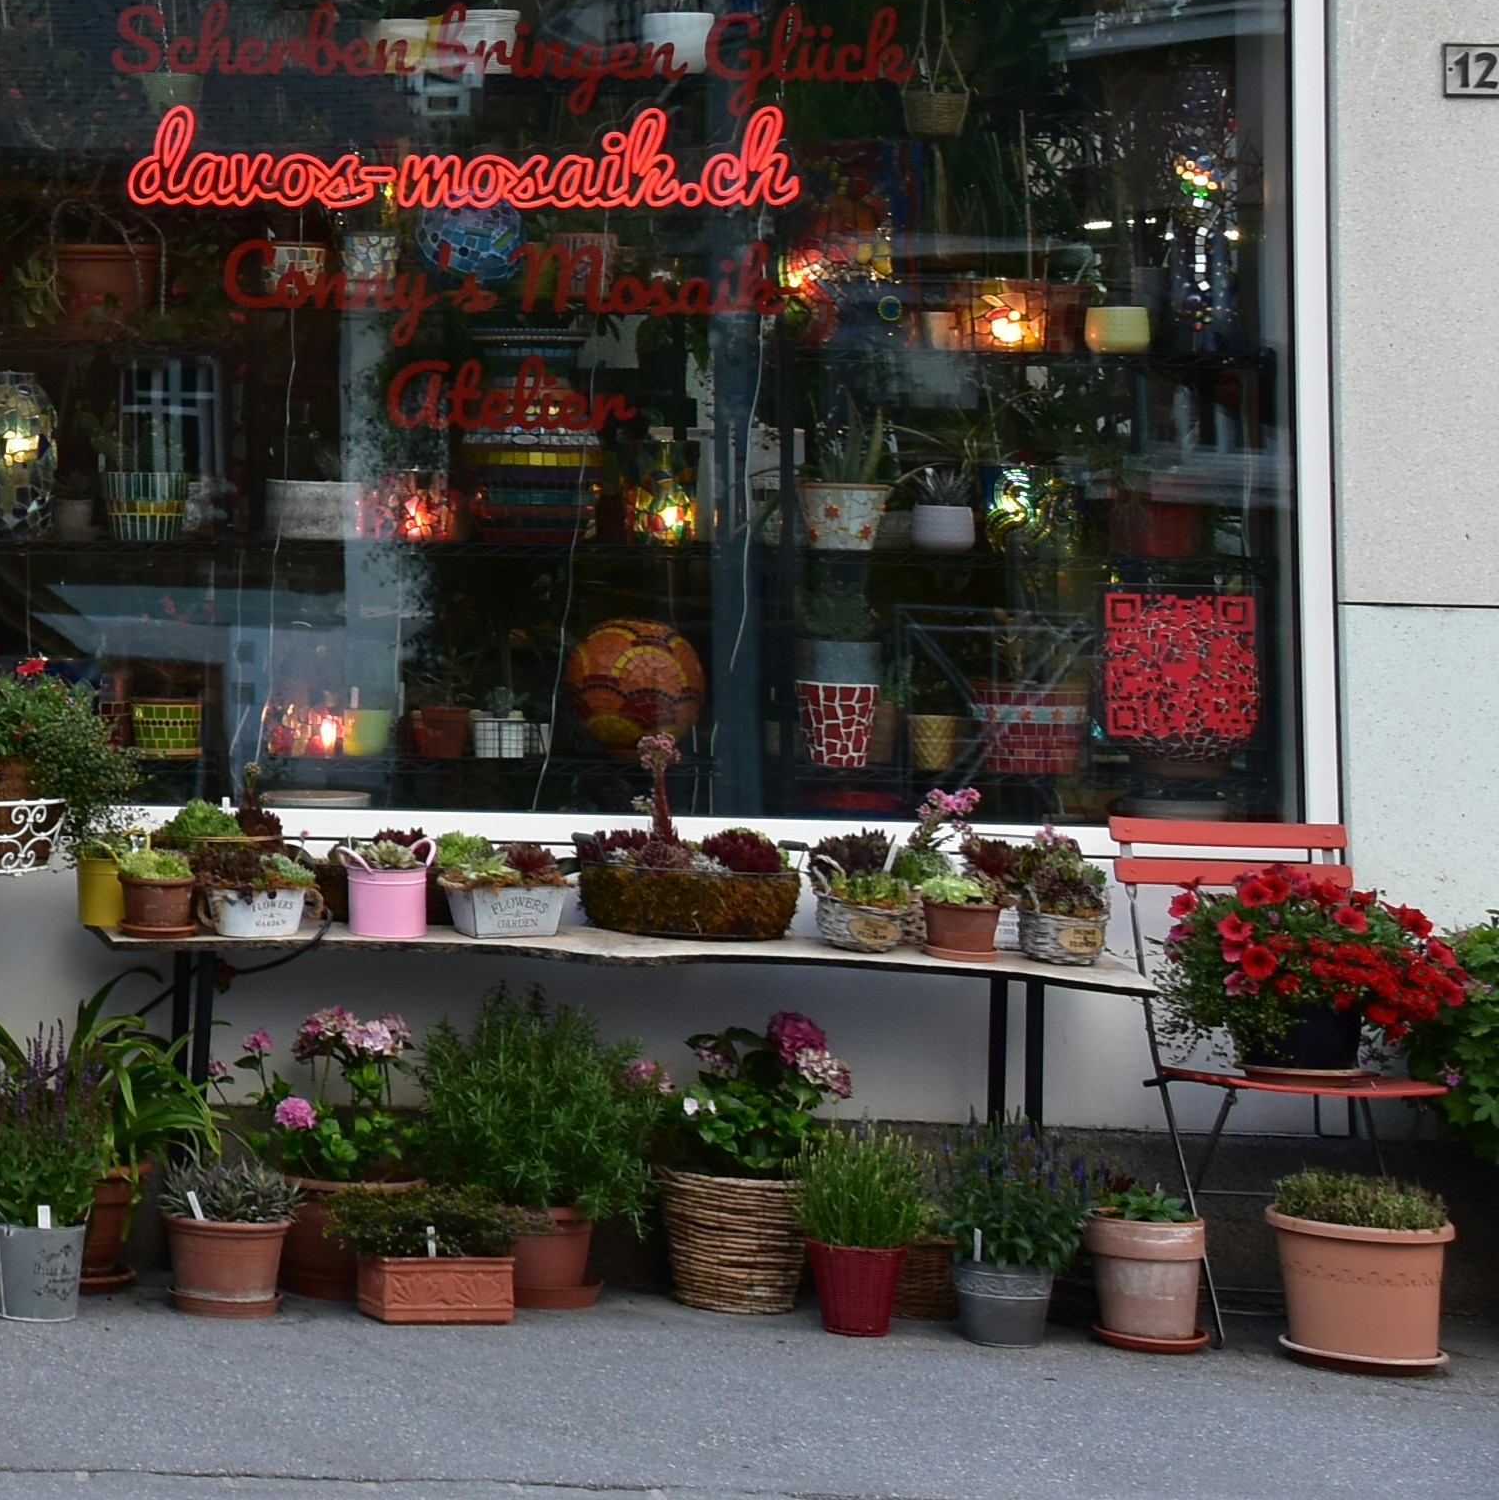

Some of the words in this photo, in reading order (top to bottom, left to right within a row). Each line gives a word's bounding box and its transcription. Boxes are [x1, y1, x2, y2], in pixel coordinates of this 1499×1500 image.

[111, 0, 414, 77] Scherben
[423, 2, 688, 114] bringen
[703, 6, 915, 115] Glück
[1453, 51, 1499, 90] 12
[127, 104, 801, 209] davos-mosaik.ch
[222, 238, 498, 347] Conny's
[512, 240, 793, 315] Mosaik
[387, 356, 636, 430] Atelier
[251, 899, 295, 913] FLOWERS
[491, 896, 549, 915] FLOWERS
[497, 918, 538, 929] GARDEN
